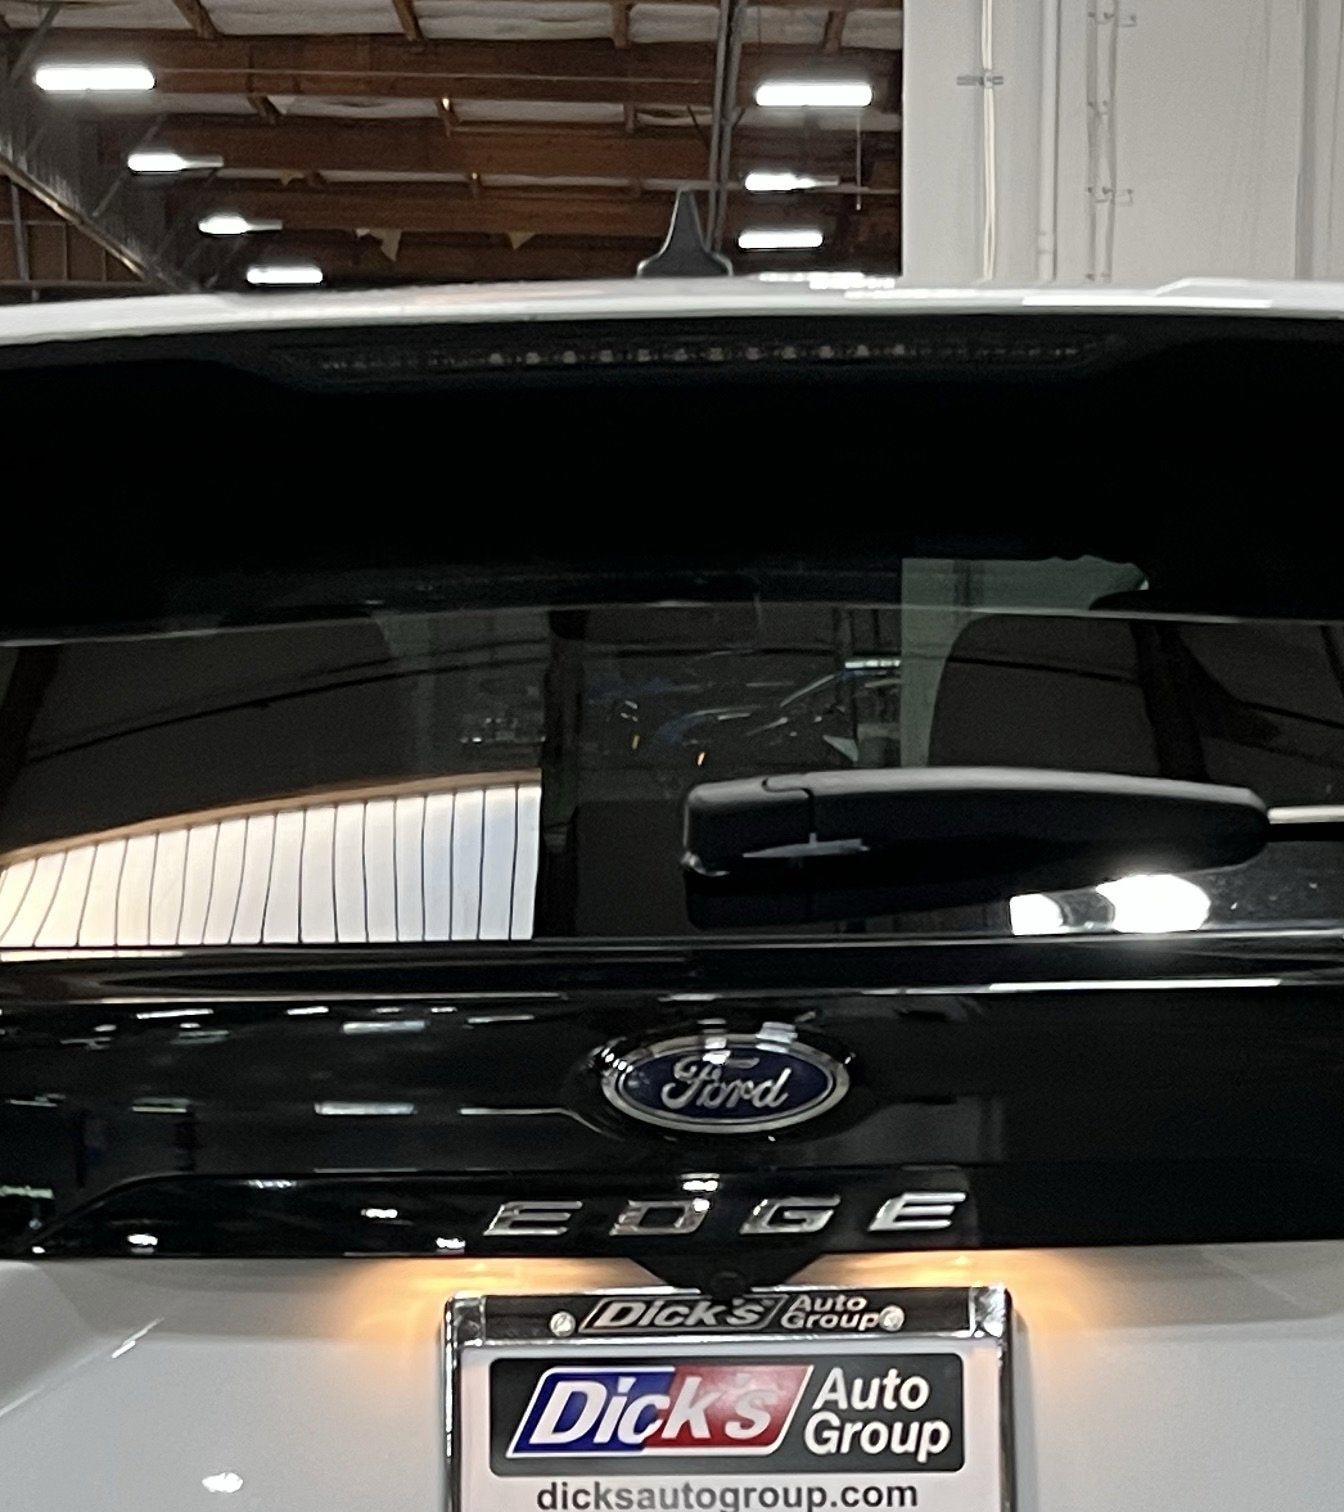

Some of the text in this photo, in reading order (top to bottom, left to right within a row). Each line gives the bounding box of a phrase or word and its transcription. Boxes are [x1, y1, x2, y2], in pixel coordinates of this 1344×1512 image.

[661, 1053, 792, 1110] Ford
[483, 1192, 966, 1236] EDGE
[780, 1309, 880, 1331] Group
[789, 1293, 867, 1313] Auto
[529, 1374, 773, 1444] Dick's
[812, 1367, 930, 1411] Auto
[804, 1411, 951, 1463] Group
